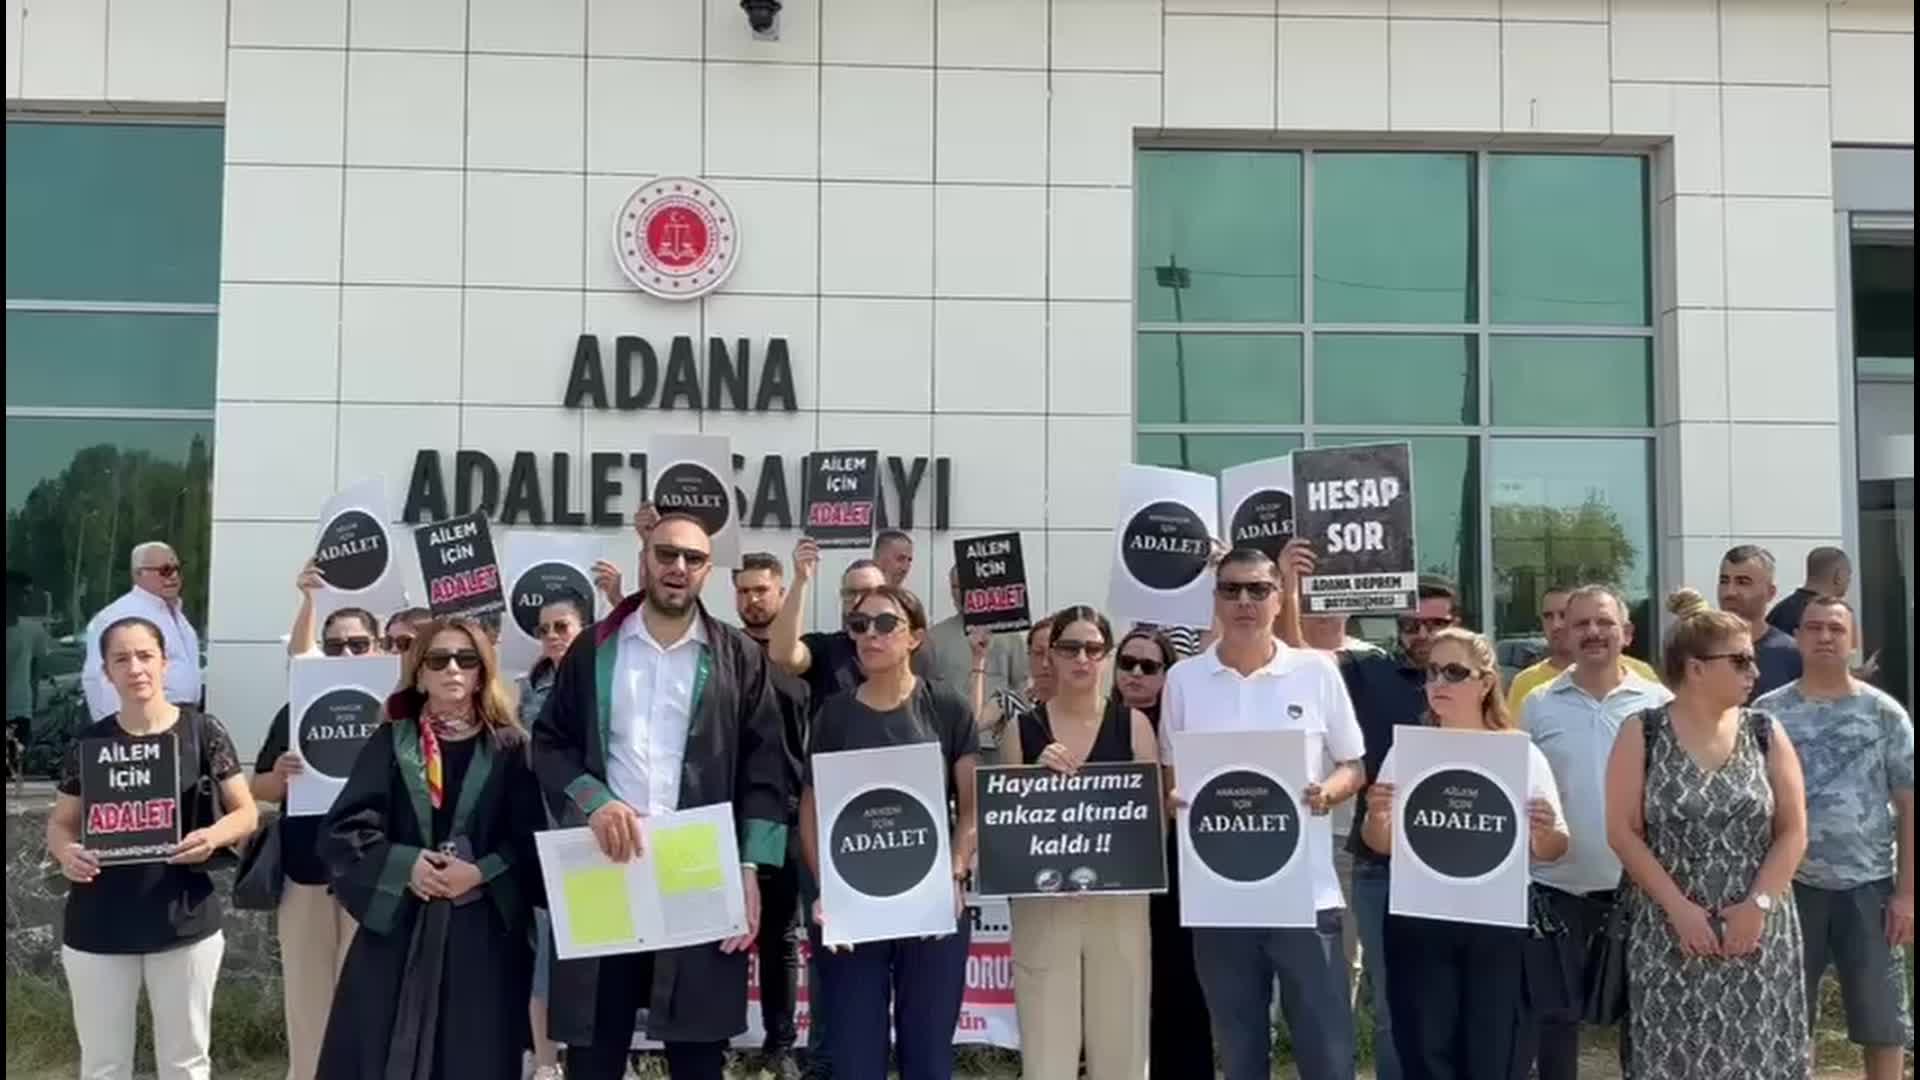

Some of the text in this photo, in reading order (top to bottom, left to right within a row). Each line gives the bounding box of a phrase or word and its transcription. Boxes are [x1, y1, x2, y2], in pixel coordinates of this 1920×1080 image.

[564, 334, 797, 411] ADANA
[820, 455, 866, 471] AİLEM
[826, 474, 858, 492] İÇİN
[1308, 476, 1399, 512] HESAP
[660, 494, 722, 507] ADALET
[807, 501, 873, 526] ADALET
[428, 521, 478, 547] AİLEM
[1236, 519, 1293, 541] ADALE
[1327, 520, 1385, 553] SOR
[318, 534, 382, 562] ADALET
[440, 543, 475, 565] İÇİN
[966, 539, 1011, 559] AİLEM
[1130, 534, 1204, 555] ADALET
[430, 563, 498, 605] ADALET
[1312, 575, 1402, 591] ADANA DEPREM
[964, 583, 1026, 614] ADALET
[97, 742, 160, 764] AİLEM
[109, 767, 150, 791] İÇİN
[987, 773, 1143, 797] Hayatlarımız
[87, 798, 176, 834] ADALET
[985, 801, 1148, 825] enkaz altında
[1199, 814, 1290, 832] ADALET
[1413, 809, 1507, 832] ADALET
[840, 828, 928, 853] ADALET
[1029, 833, 1112, 856] kaldı !!
